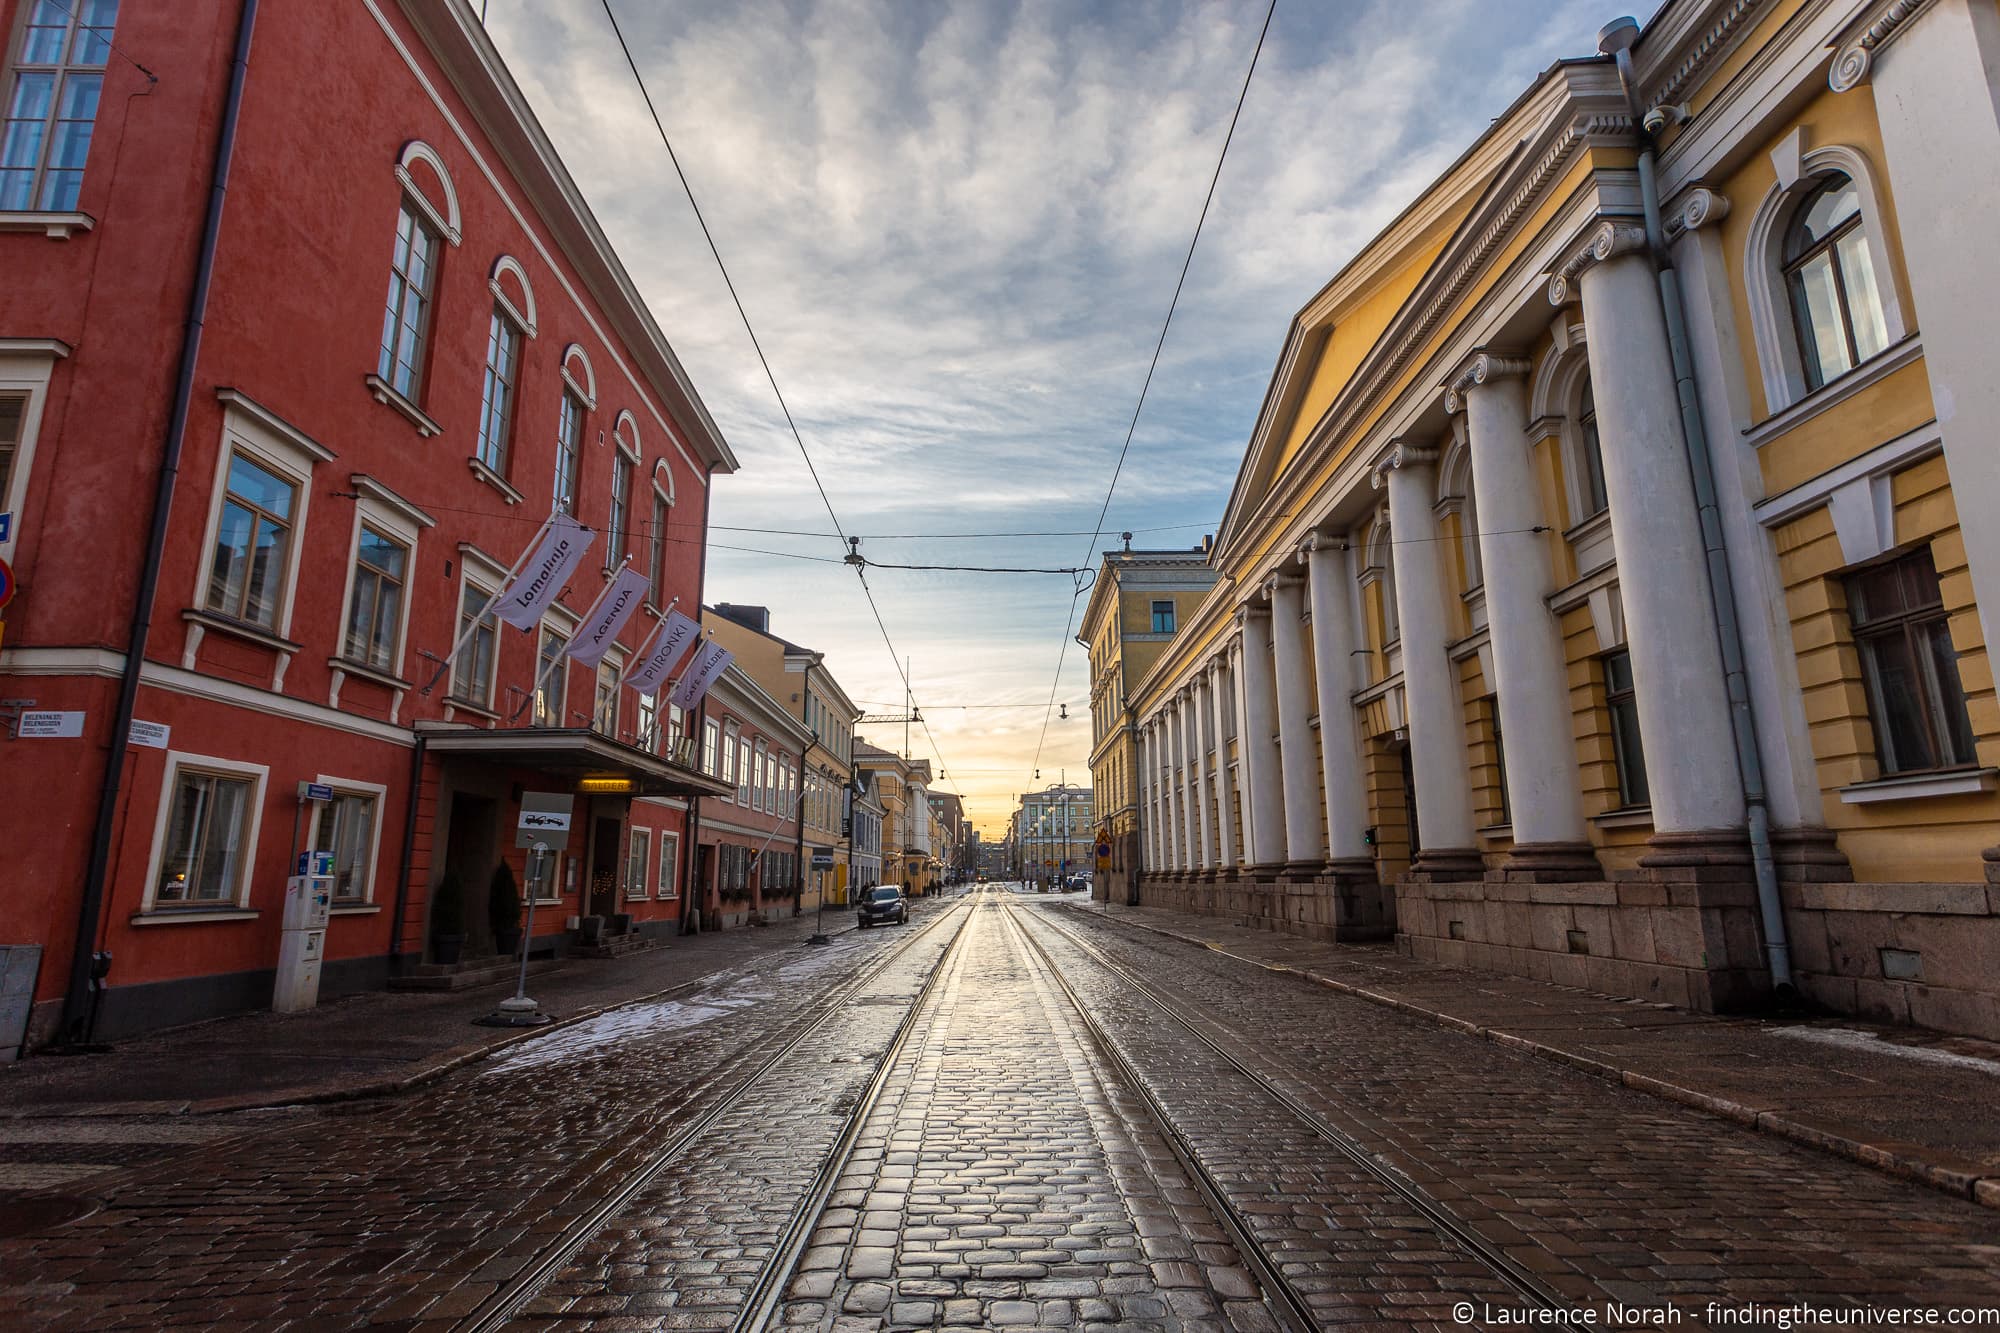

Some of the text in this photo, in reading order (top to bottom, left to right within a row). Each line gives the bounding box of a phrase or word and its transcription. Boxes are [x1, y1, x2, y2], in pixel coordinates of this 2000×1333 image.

[516, 539, 570, 609] Lomalinja
[593, 589, 633, 645] AGENDA
[644, 624, 688, 681] PIIRONKI
[700, 647, 727, 677] BALDER
[584, 782, 624, 790] BALDER
